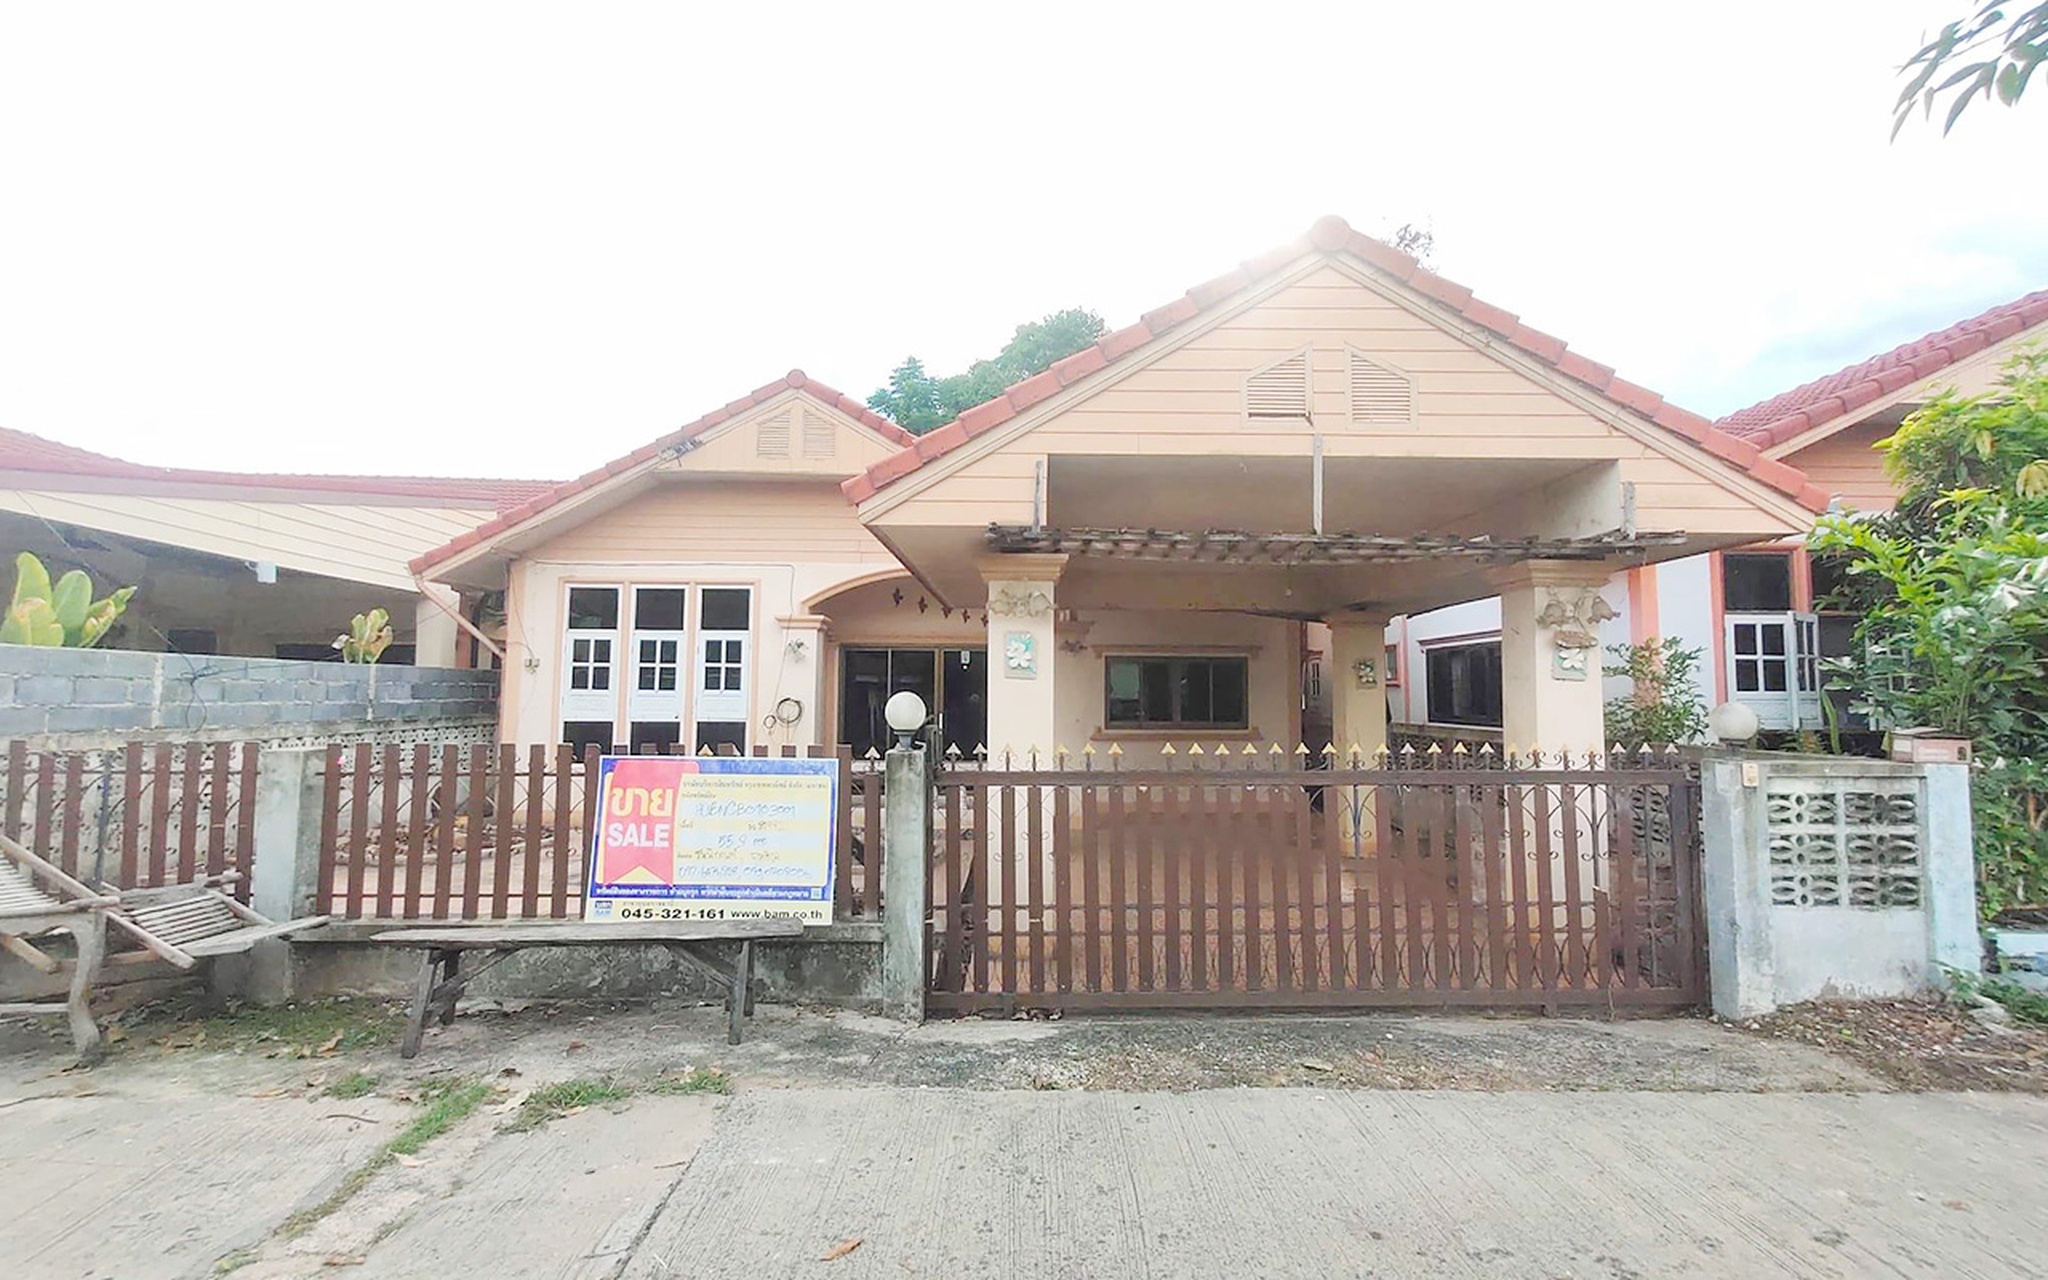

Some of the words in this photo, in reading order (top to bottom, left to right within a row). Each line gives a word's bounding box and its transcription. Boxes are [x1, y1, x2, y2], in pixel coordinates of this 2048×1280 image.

[611, 786, 672, 817] ขาย
[607, 823, 670, 847] SALE
[621, 908, 726, 919] 045-321-161
[730, 908, 823, 919] www.bam.co.th
